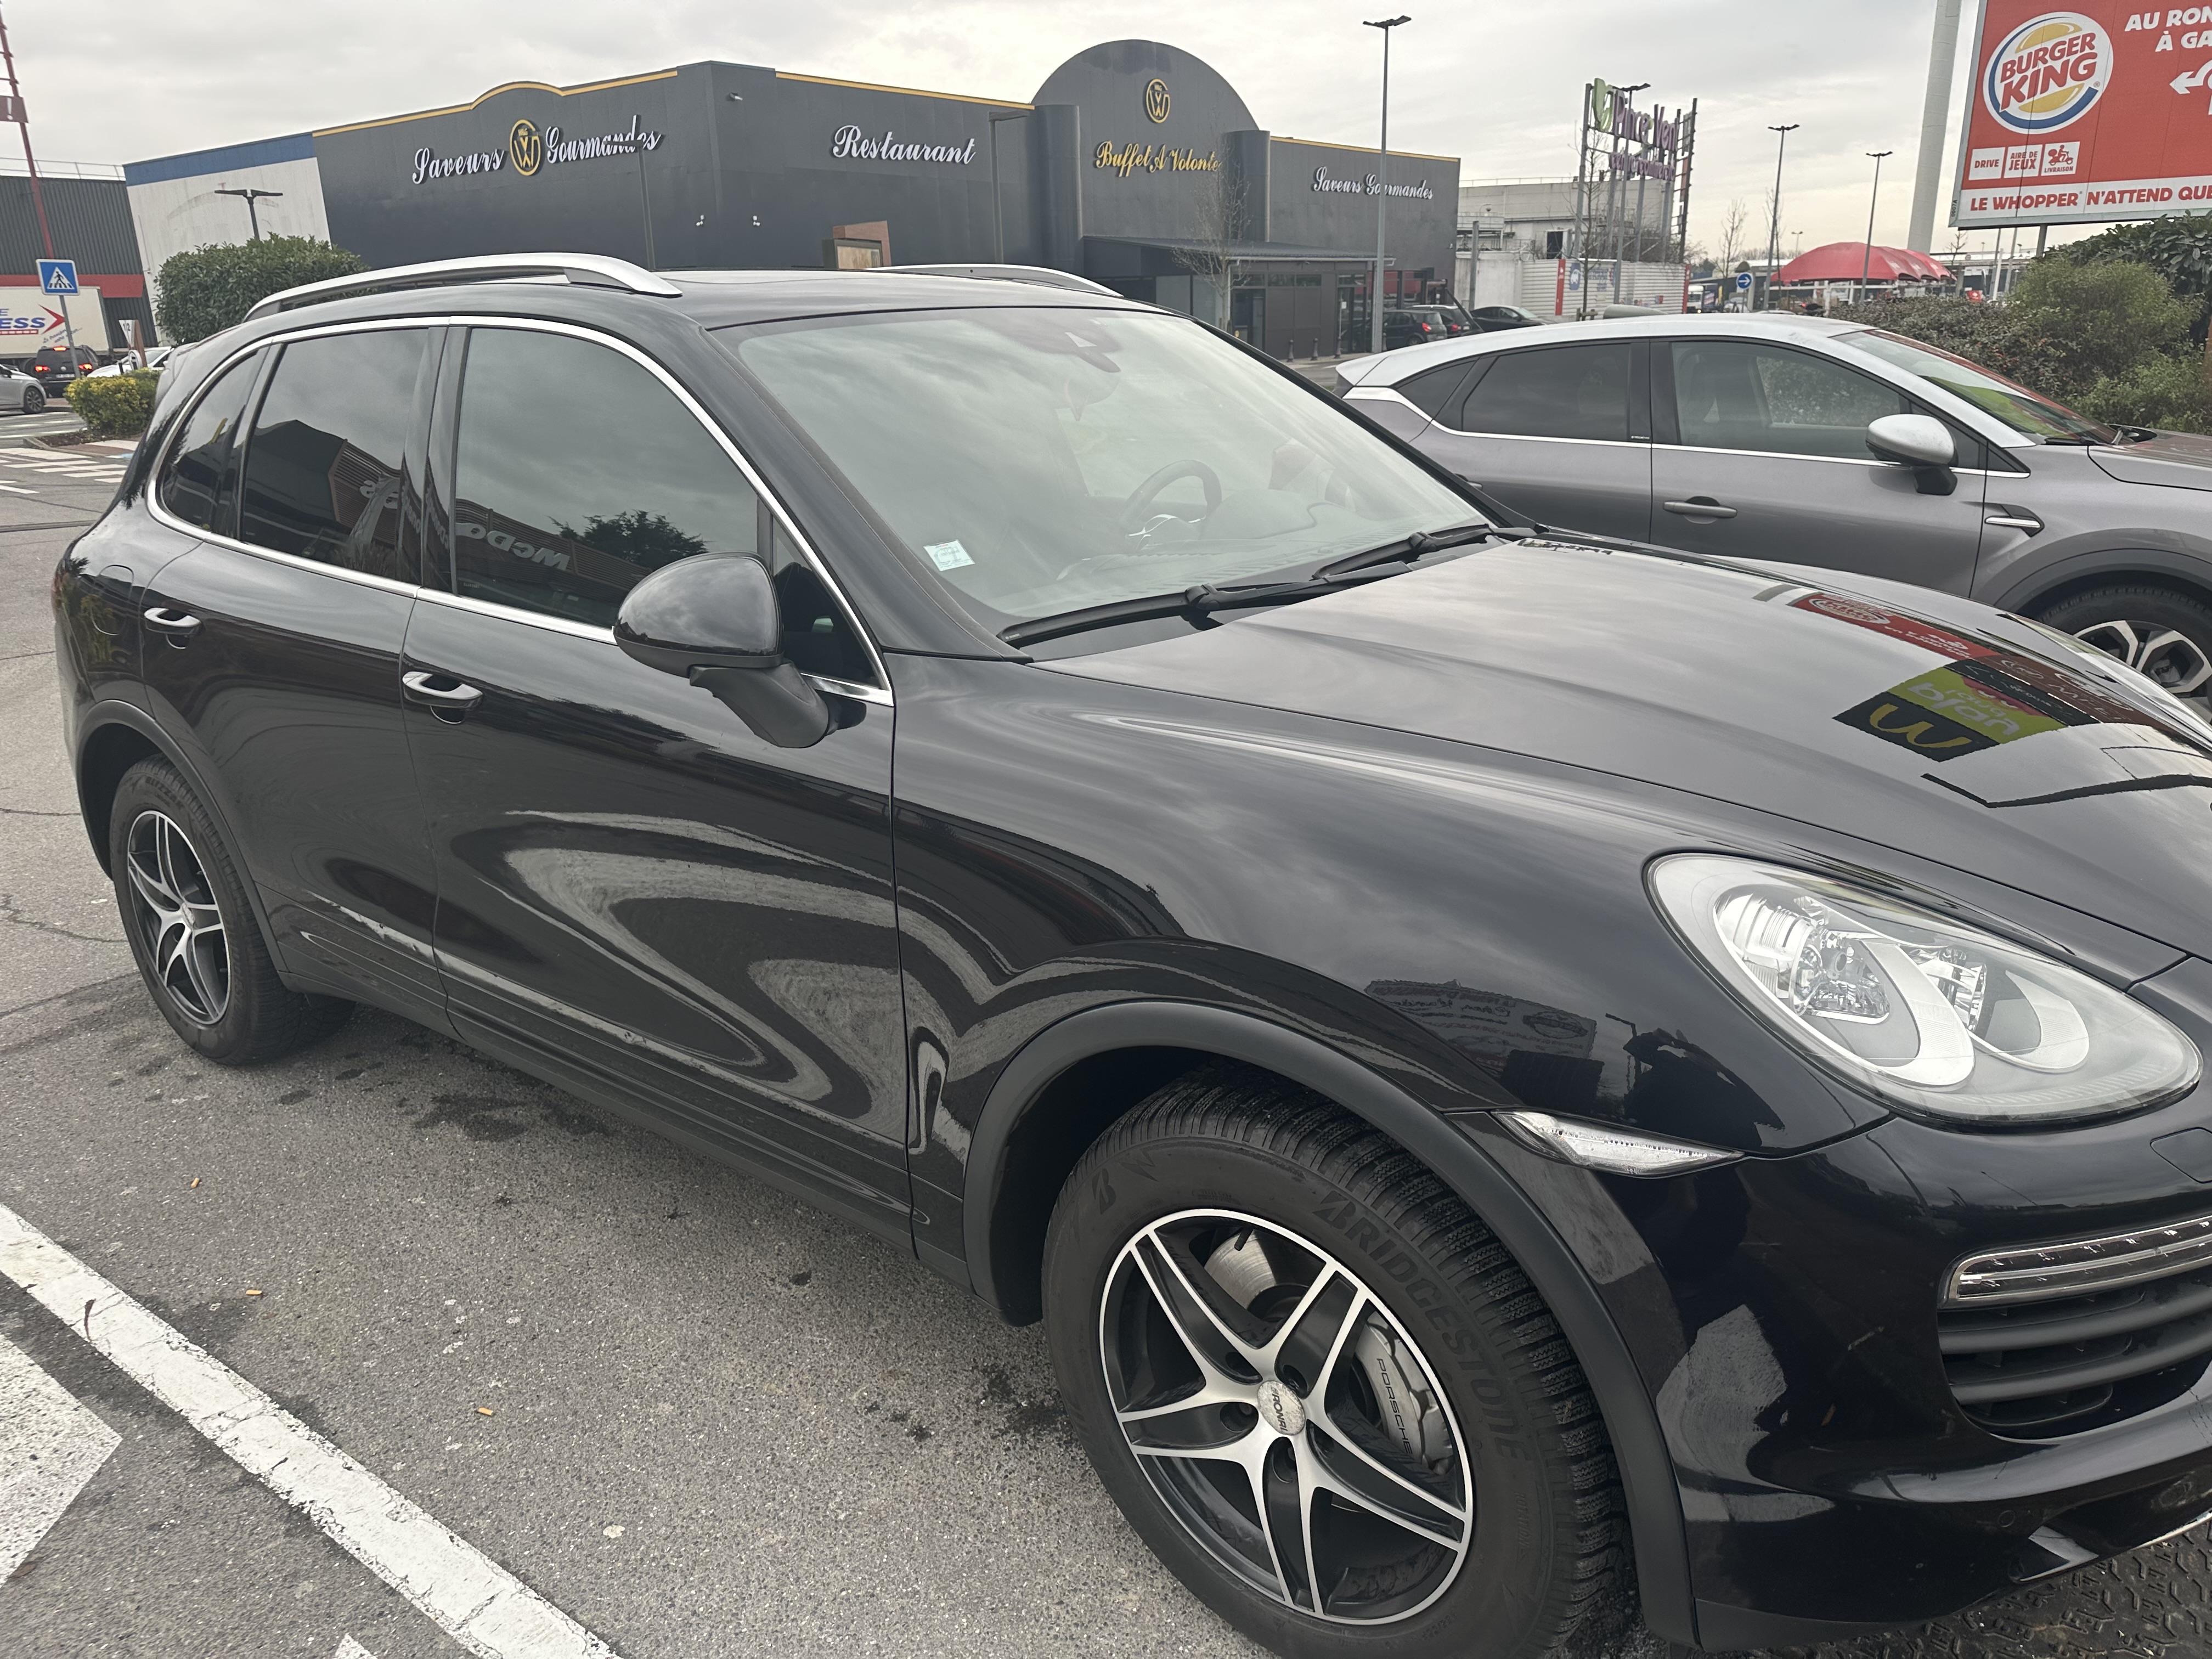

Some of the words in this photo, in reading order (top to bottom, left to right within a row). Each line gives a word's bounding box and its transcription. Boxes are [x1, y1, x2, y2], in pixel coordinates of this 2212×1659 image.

[2124, 12, 2160, 31] AU
[2000, 32, 2096, 83] BURGER
[2155, 31, 2173, 52] À
[2181, 30, 2212, 49] GA
[2001, 52, 2097, 110] KING
[832, 125, 977, 165] Restaurant
[1096, 140, 1152, 177] Buffet
[1149, 144, 1170, 173] A
[1974, 159, 2000, 168] DRIVE
[2010, 151, 2027, 160] AIRE
[412, 147, 504, 184] Saveurs
[1314, 166, 1364, 193] Saveurs
[2008, 159, 2036, 171] JEUX
[1970, 198, 1988, 211] LE
[1993, 193, 2079, 210] WHOPPER
[1312, 1189, 1532, 1462] BRIDGESTONE
[1269, 1392, 1289, 1432] RONAL
[1376, 1358, 1413, 1455] PORSCHE
